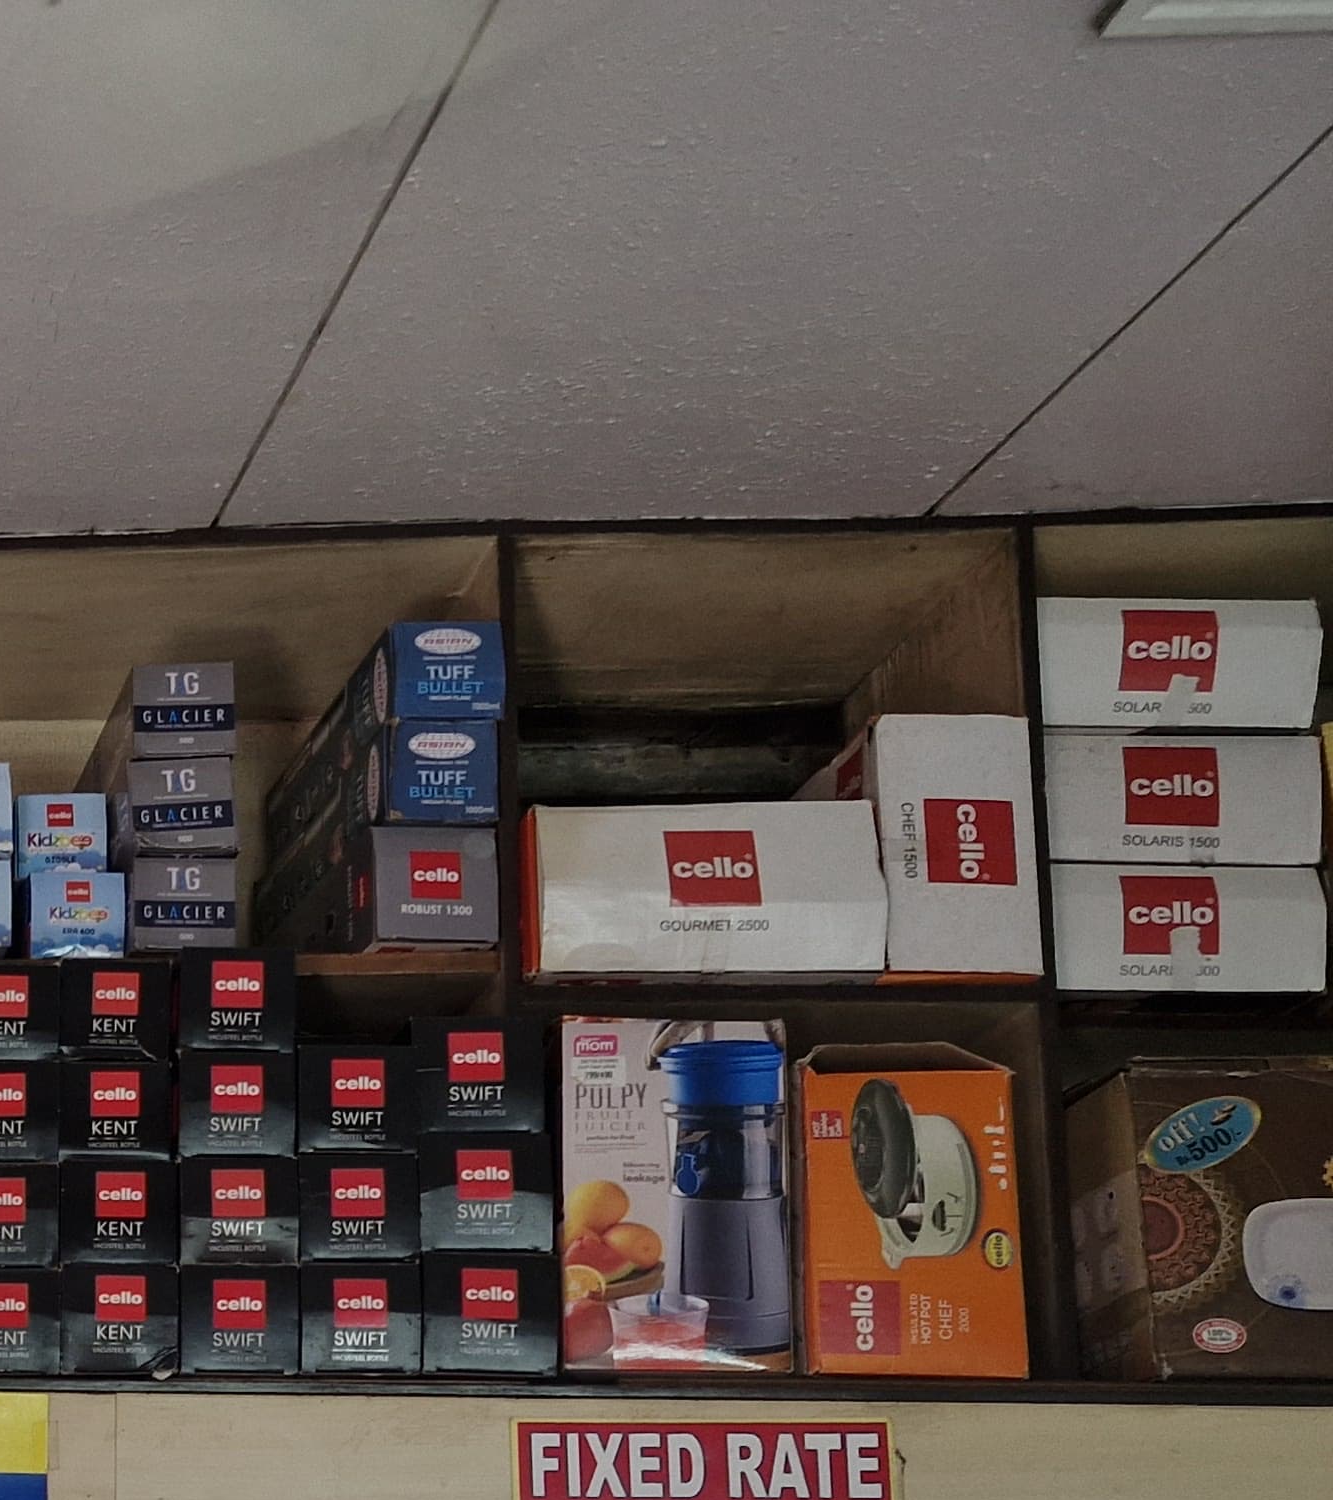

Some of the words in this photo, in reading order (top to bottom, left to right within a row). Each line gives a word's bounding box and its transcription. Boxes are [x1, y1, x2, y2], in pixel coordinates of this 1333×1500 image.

[1127, 635, 1212, 660] cello
[165, 672, 201, 695] TG
[426, 665, 475, 680] TUFF
[417, 681, 484, 694] BULLET
[142, 708, 226, 723] GLACIER
[1129, 775, 1214, 797] cello
[900, 801, 916, 841] CHEF
[956, 804, 985, 880] cello
[1122, 834, 1184, 847] SOLARIS
[1188, 837, 1220, 849] 1500
[672, 856, 754, 879] cello
[901, 844, 918, 879] 1500
[413, 868, 460, 883] cello
[400, 903, 442, 915] ROBUST
[445, 904, 473, 915] 1300
[1128, 902, 1214, 925] cello
[659, 919, 733, 933] GOURMET
[736, 919, 770, 932] 2500
[214, 979, 261, 992] cello
[210, 1012, 262, 1027] SWIFT
[452, 1050, 501, 1064] cello
[449, 1086, 504, 1101] SWIFT
[575, 1083, 648, 1109] PULPY
[850, 1284, 874, 1351] cello
[939, 1299, 953, 1340] CHEF
[959, 1307, 969, 1332] 2000
[530, 1432, 707, 1498] FIXED
[726, 1432, 883, 1499] RATE
